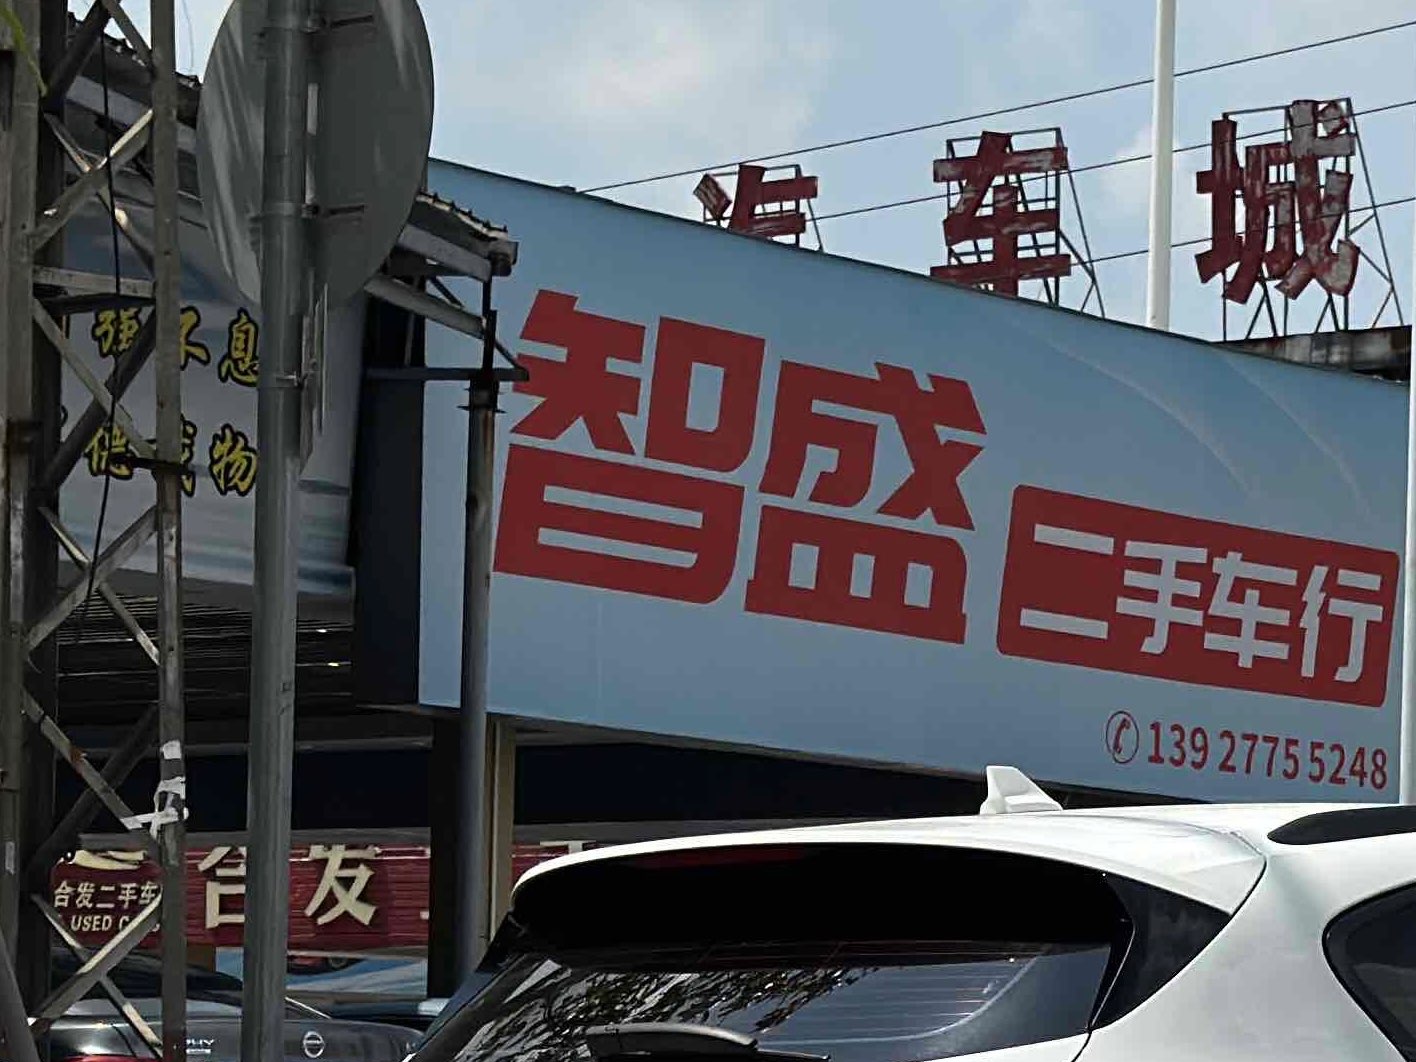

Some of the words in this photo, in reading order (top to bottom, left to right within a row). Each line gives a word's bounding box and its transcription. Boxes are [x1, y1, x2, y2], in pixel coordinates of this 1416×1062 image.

[493, 289, 988, 644] 智盛
[1019, 523, 1384, 684] 二手车行
[53, 880, 160, 909] 合发二手车
[70, 914, 113, 932] USED
